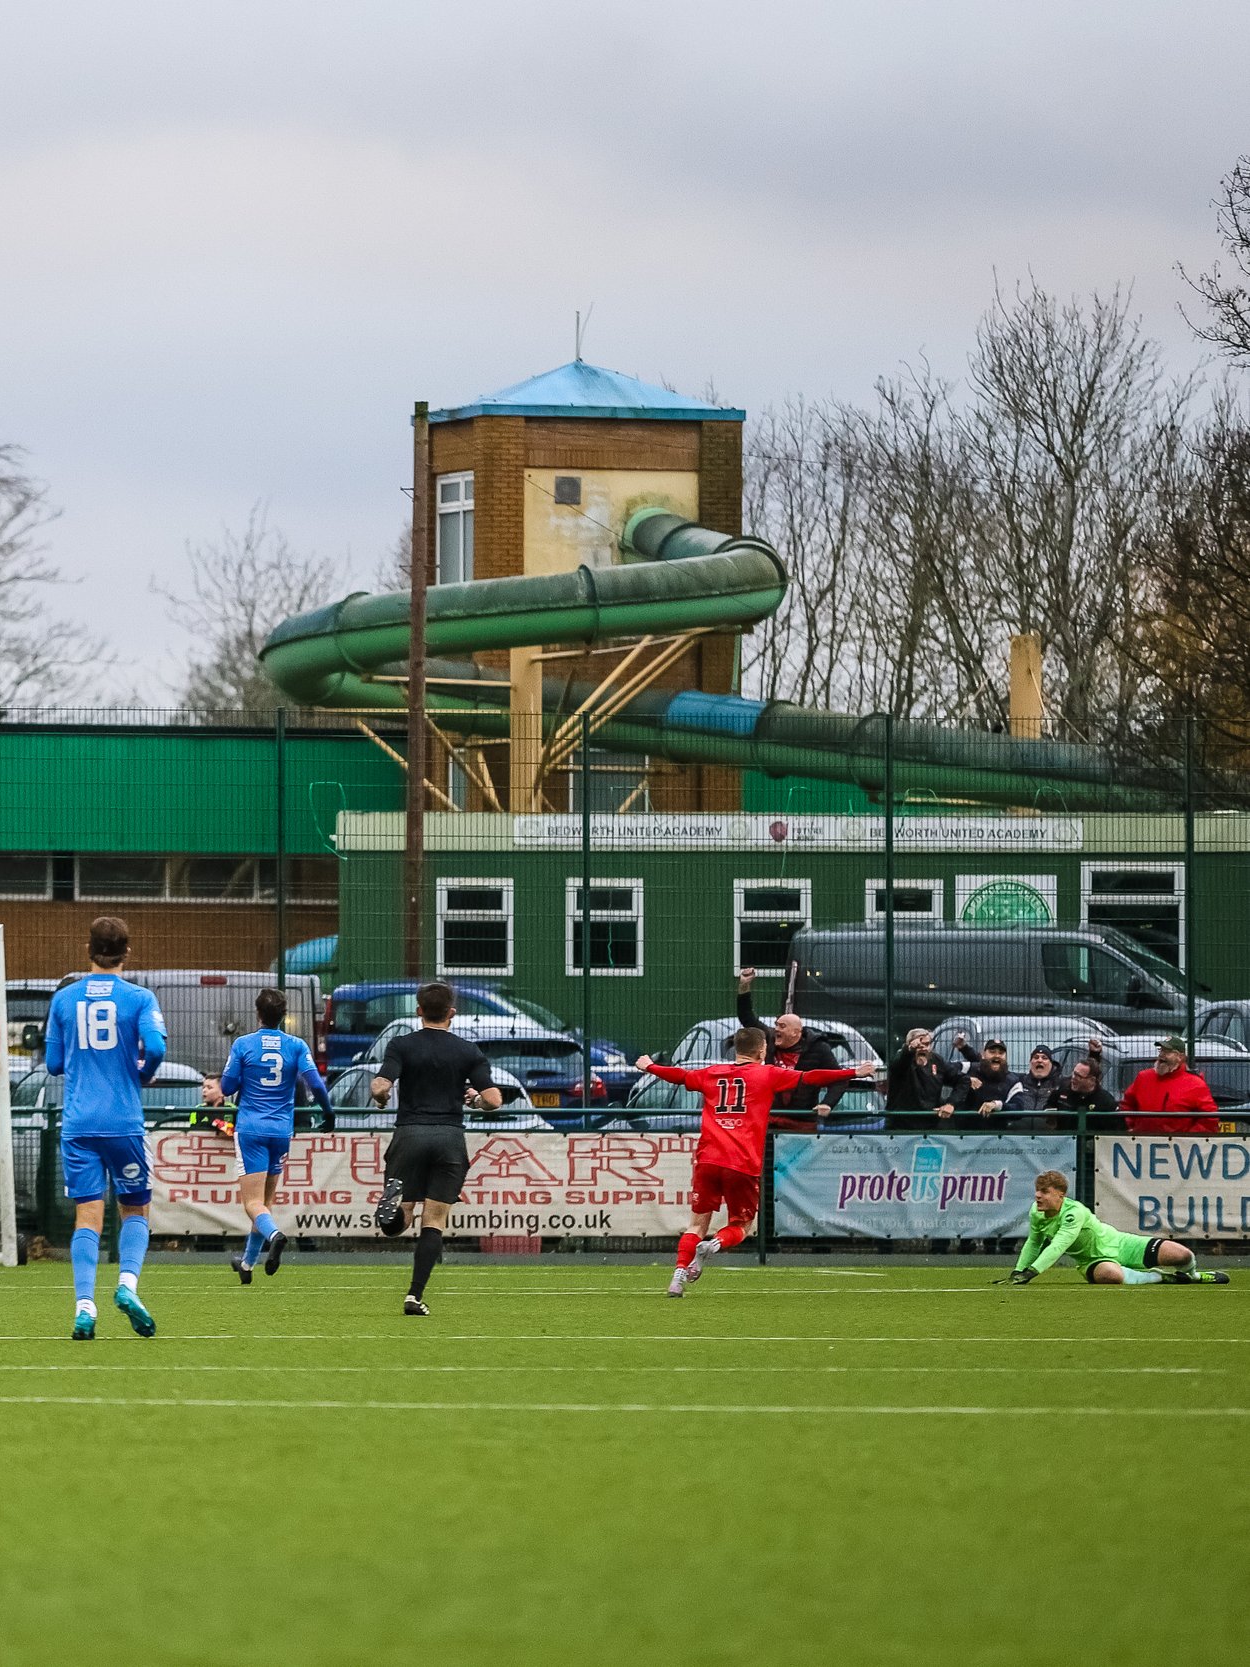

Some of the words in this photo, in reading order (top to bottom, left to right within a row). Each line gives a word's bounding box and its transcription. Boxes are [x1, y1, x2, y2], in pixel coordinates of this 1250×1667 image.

[547, 826, 614, 837] BEDWRTH
[618, 826, 662, 837] UNITED
[664, 826, 722, 837] ACADEMY
[869, 828, 938, 839] BEWORTH
[941, 828, 984, 839] UNITED
[988, 828, 1047, 839] ACADEMY
[76, 1000, 118, 1051] 18
[260, 1052, 284, 1087] 3
[714, 1077, 748, 1115] 11
[168, 1188, 352, 1205] PLUBING
[564, 1189, 697, 1205] SUPPLI
[837, 1169, 1009, 1211] proteusprint
